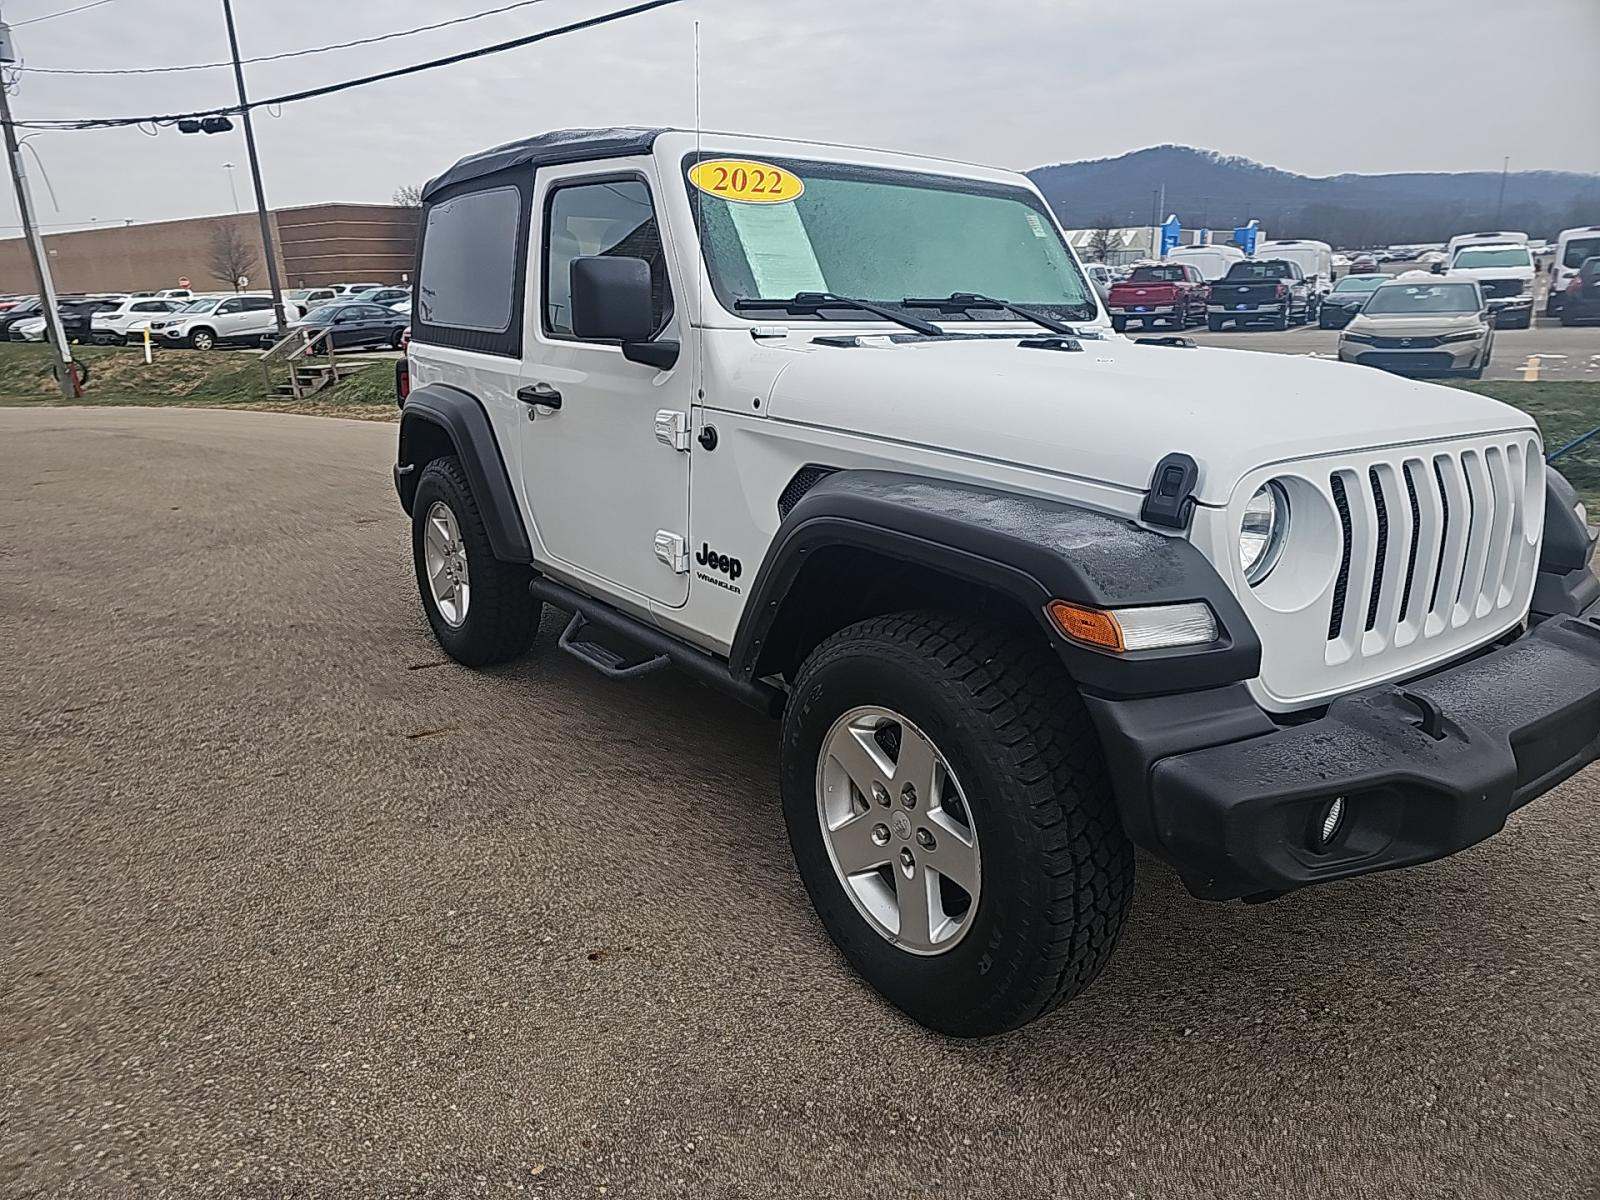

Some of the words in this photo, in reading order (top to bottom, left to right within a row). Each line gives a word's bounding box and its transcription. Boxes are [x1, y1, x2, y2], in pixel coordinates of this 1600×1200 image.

[713, 167, 783, 193] 2022
[696, 542, 742, 581] Jeep
[696, 571, 741, 594] WRANGLER
